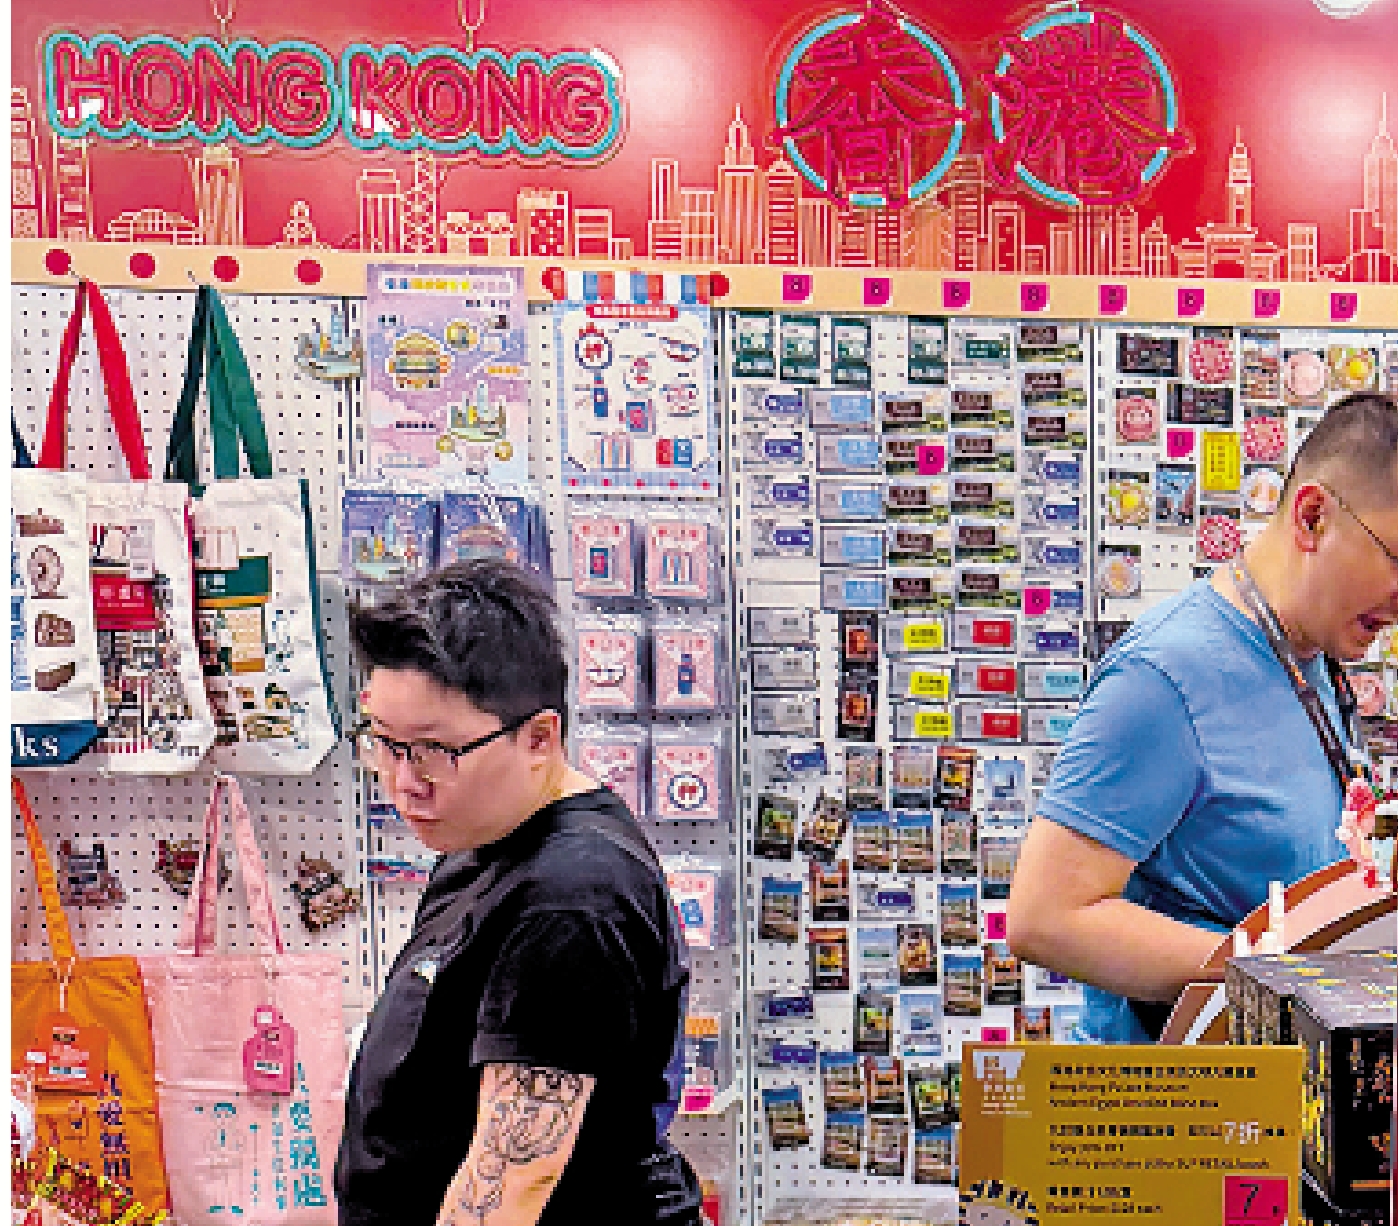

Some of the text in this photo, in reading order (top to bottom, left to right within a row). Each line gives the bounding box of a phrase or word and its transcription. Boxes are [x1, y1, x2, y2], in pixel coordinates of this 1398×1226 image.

[54, 39, 614, 152] HONG KONG
[1239, 1183, 1260, 1217] 7
